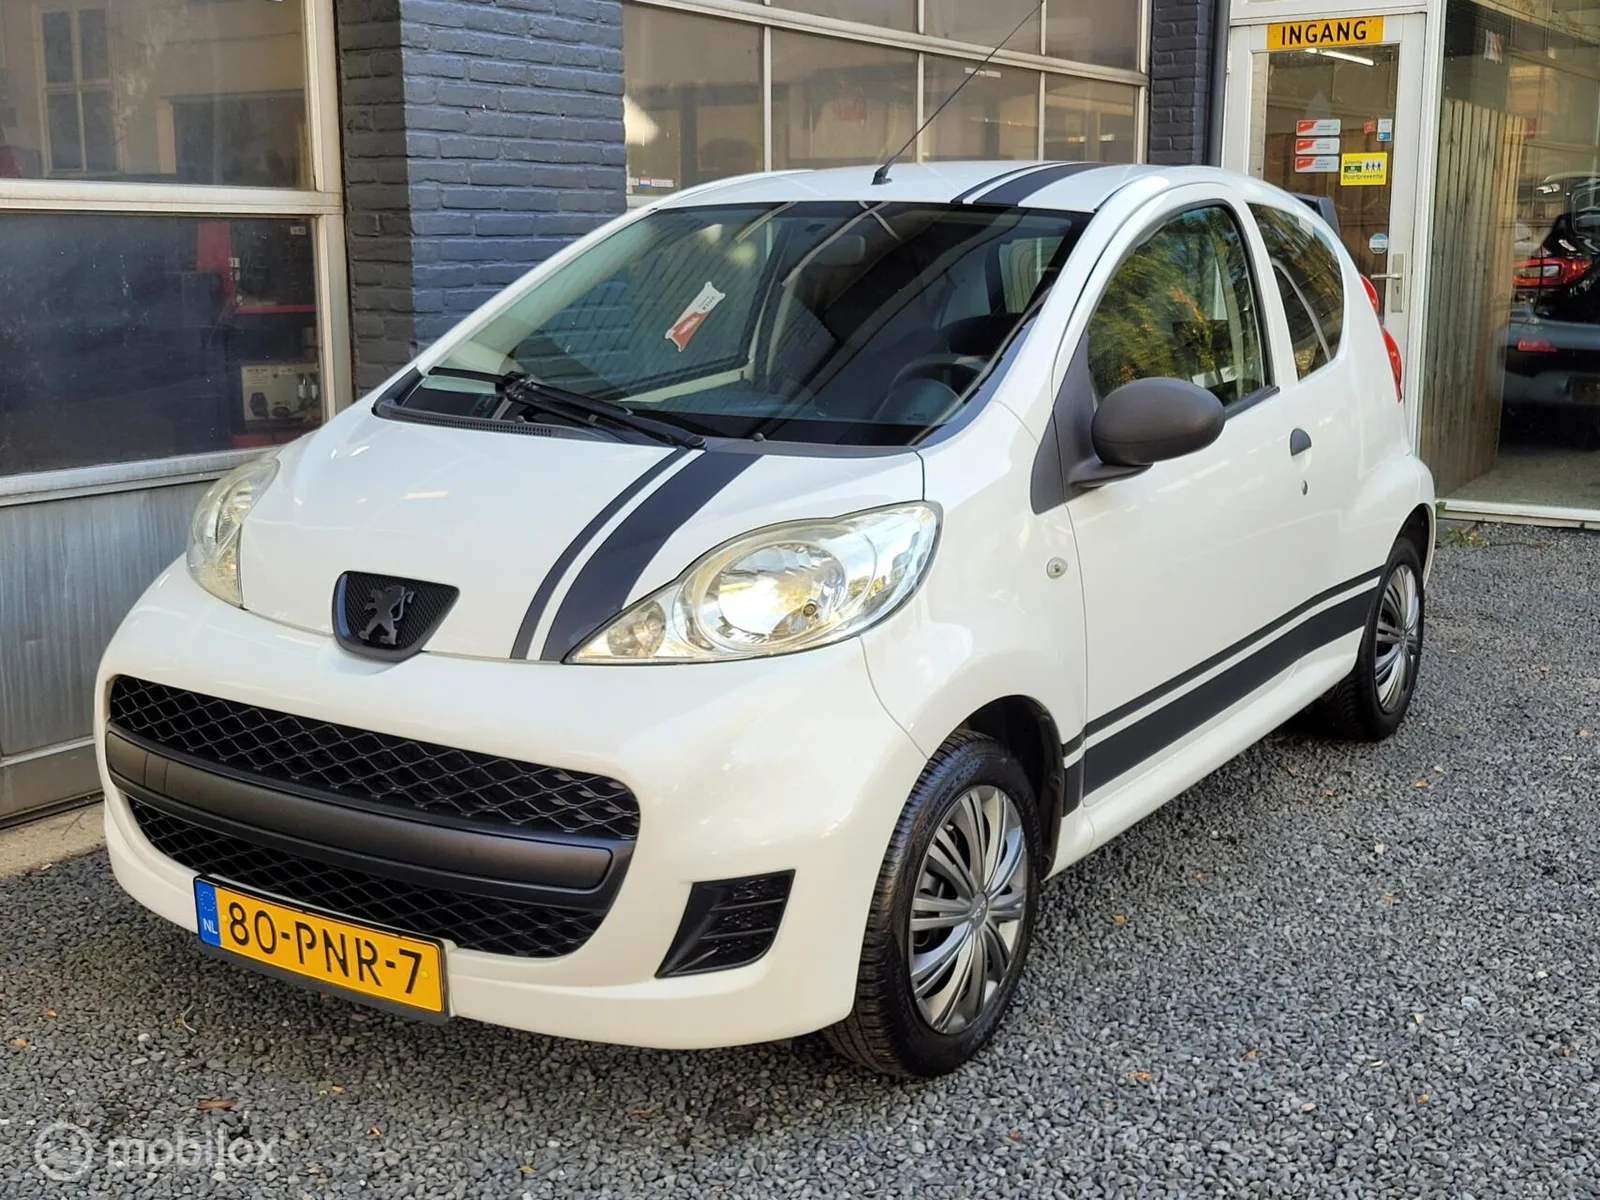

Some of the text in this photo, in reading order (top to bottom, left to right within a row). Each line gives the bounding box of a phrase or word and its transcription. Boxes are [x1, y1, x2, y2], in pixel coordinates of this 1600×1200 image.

[1281, 20, 1367, 45] INGANG
[203, 917, 218, 935] NL
[228, 902, 423, 995] 80-PNR-7
